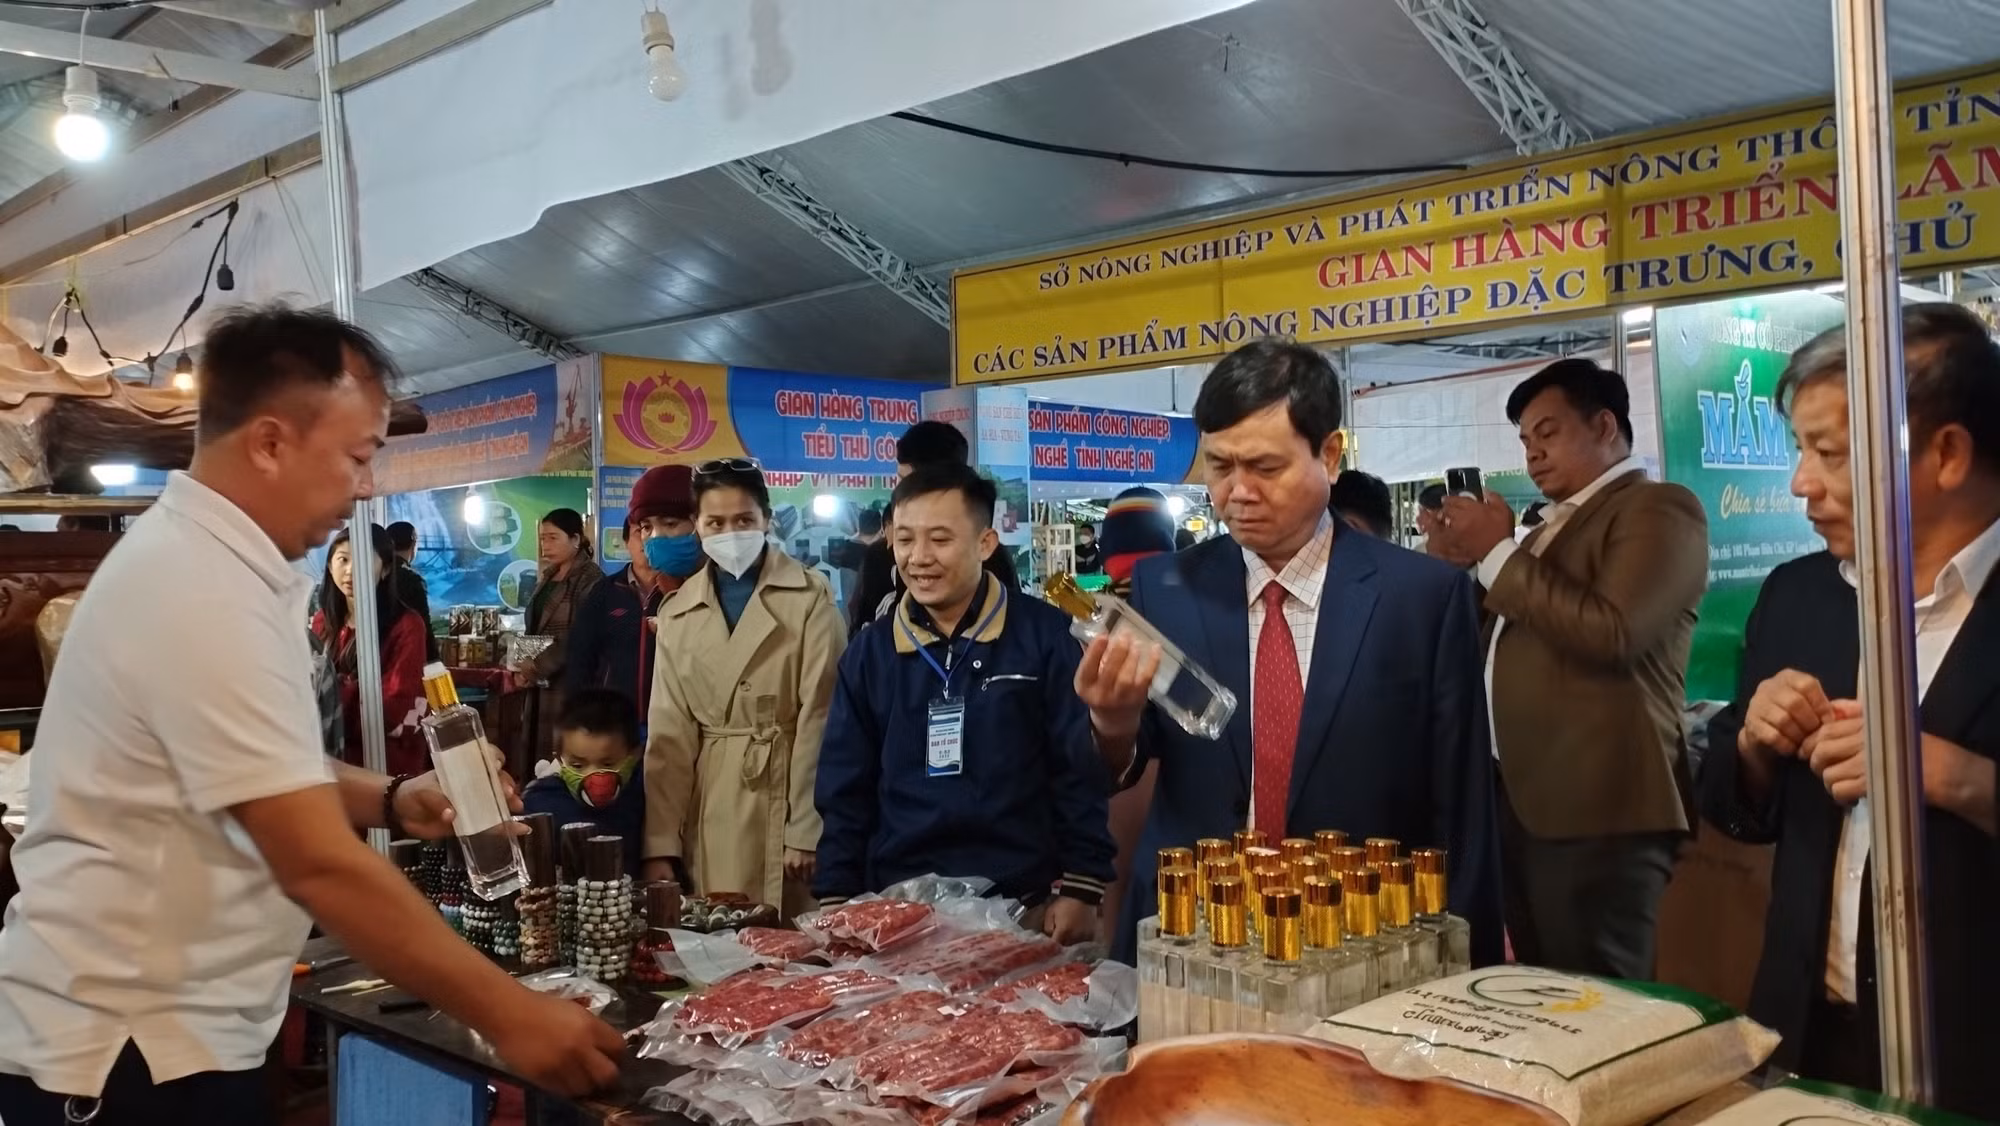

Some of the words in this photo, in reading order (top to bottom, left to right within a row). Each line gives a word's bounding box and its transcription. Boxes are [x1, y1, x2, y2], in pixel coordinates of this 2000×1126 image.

[1040, 261, 1070, 290] SỞ
[1079, 251, 1151, 285] NÔNG
[1161, 229, 1274, 269] NGHIỆP
[1285, 214, 1326, 246] VÀ
[1340, 198, 1436, 238] PHÁT
[1447, 167, 1572, 219] TRIỂN
[1587, 143, 1720, 192] NÔNG
[1738, 115, 1838, 163] THÔ
[1318, 240, 1436, 289] GIAN
[1451, 210, 1612, 269] HÀNG
[1632, 159, 1839, 242] TRIỂN
[973, 342, 1025, 376] CÁC
[1033, 332, 1089, 369] SẢN
[1098, 318, 1187, 362] PHẨM
[1199, 310, 1299, 350] NÔNG
[1311, 283, 1472, 333] NGHIỆP
[1486, 268, 1586, 313] ĐẶC
[1603, 237, 1815, 297] TRƯNG,
[1836, 199, 1978, 262] HỦ
[775, 389, 816, 419] GIAN
[818, 388, 864, 422] HÀNG
[1028, 402, 1053, 432] SẢN
[1054, 405, 1092, 435] PHẨM
[1094, 409, 1128, 438] CÔNG
[802, 423, 837, 460] TIỂU
[840, 428, 871, 461] THỦ
[874, 431, 901, 462] CÔ
[1033, 437, 1069, 469] NGHỀ
[1074, 439, 1103, 470] TỈNH
[1104, 444, 1136, 477] NGHỆ
[1137, 449, 1155, 473] AN
[1721, 483, 1751, 519] Chia
